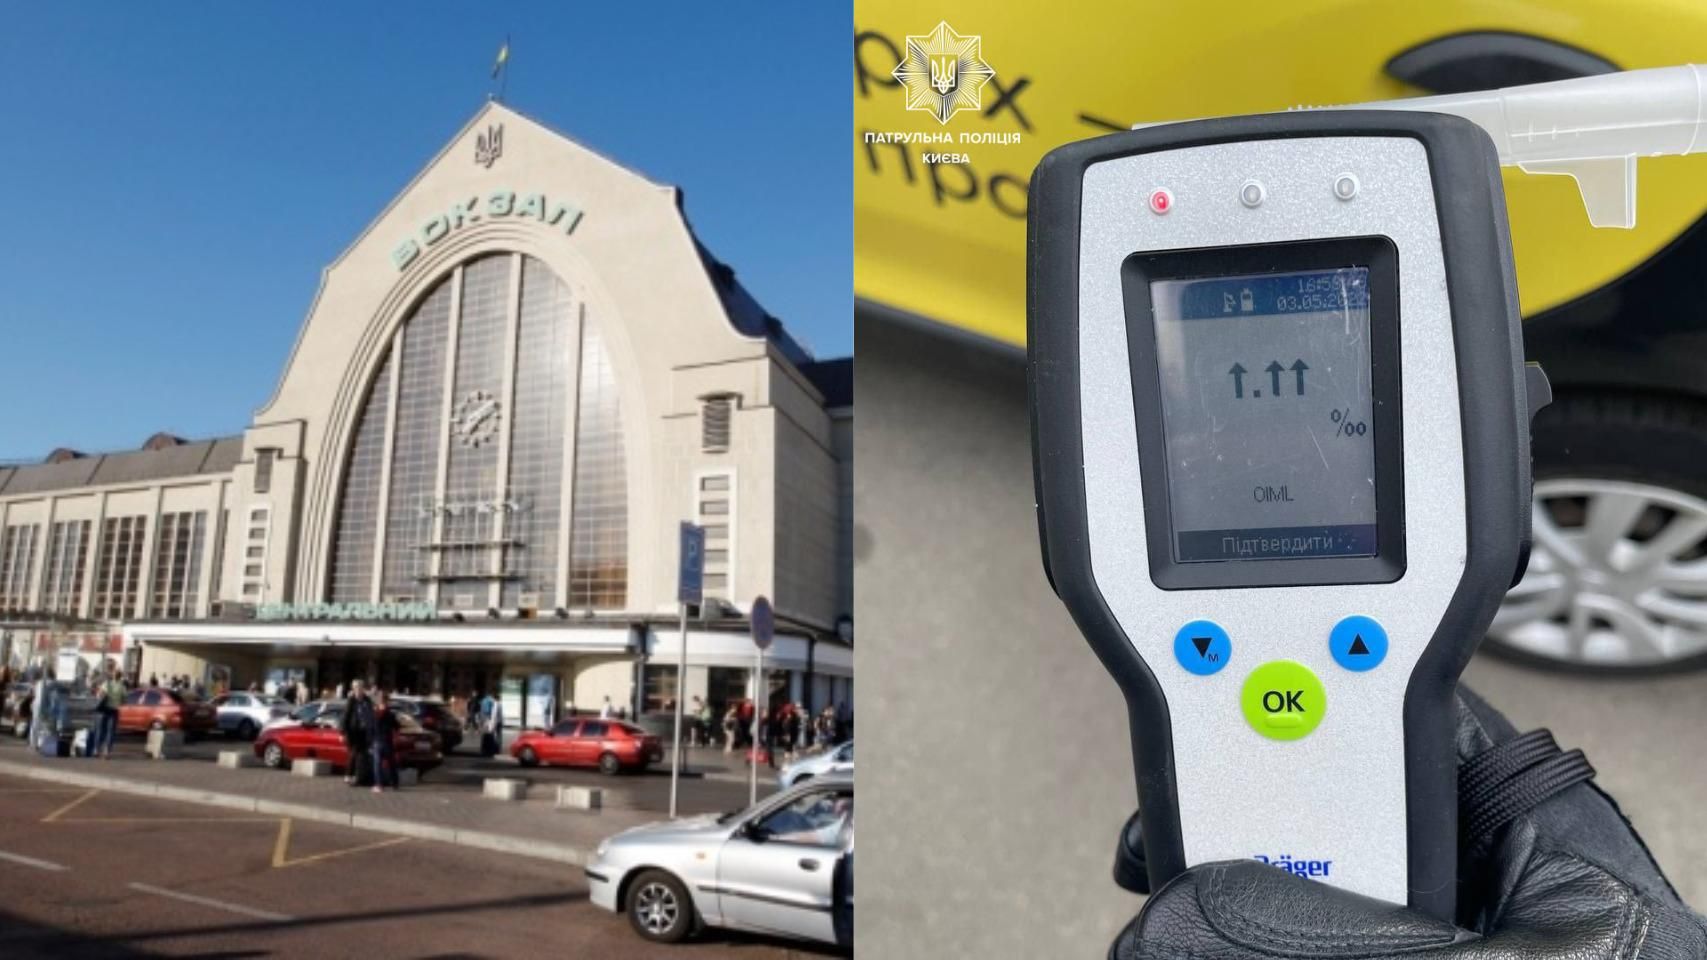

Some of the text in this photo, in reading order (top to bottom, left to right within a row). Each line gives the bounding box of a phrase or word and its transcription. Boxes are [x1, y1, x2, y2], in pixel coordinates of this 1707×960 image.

[854, 27, 1033, 132] рх
[391, 188, 585, 271] ВОКЗАЛ
[1253, 485, 1295, 503] OIML
[1222, 535, 1333, 556] Підтвердити
[1208, 653, 1219, 663] M
[1262, 690, 1306, 713] OK
[1254, 855, 1332, 880] äger
